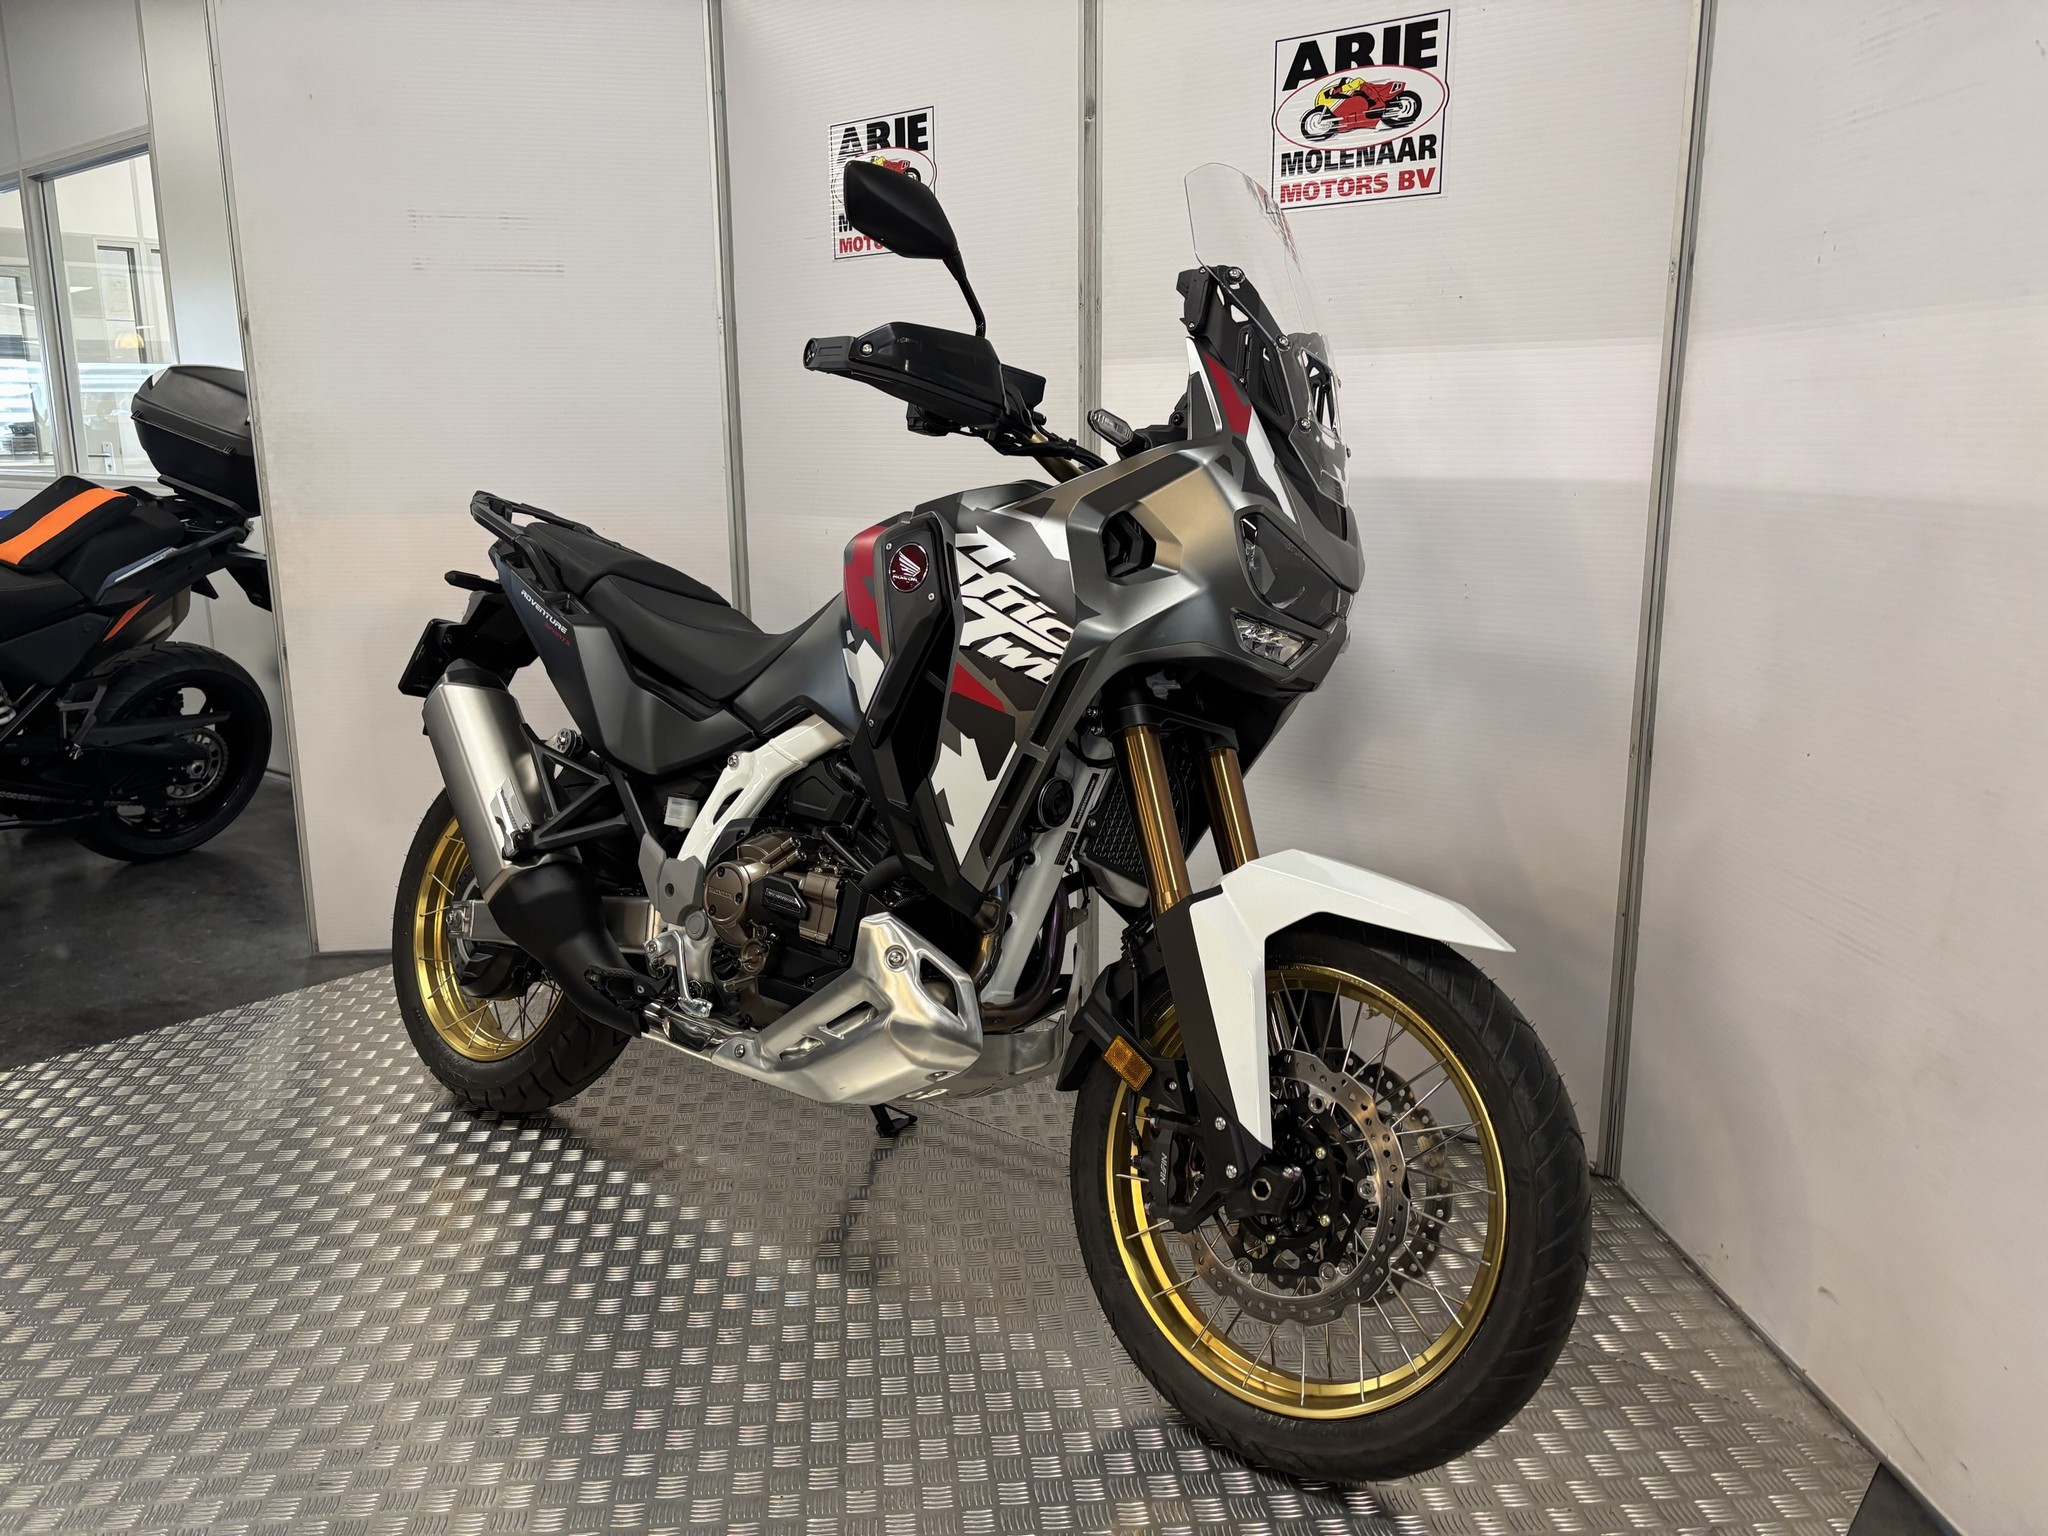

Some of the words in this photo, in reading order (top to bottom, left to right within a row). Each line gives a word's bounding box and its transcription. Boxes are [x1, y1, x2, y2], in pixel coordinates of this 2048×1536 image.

[1282, 18, 1439, 91] ARIE
[837, 113, 928, 164] ARIE
[1281, 134, 1437, 177] MOLENAAR
[1280, 172, 1388, 203] MOTORS
[1398, 167, 1436, 191] BV
[839, 236, 884, 254] MOTO
[521, 590, 567, 634] ADVENTURE
